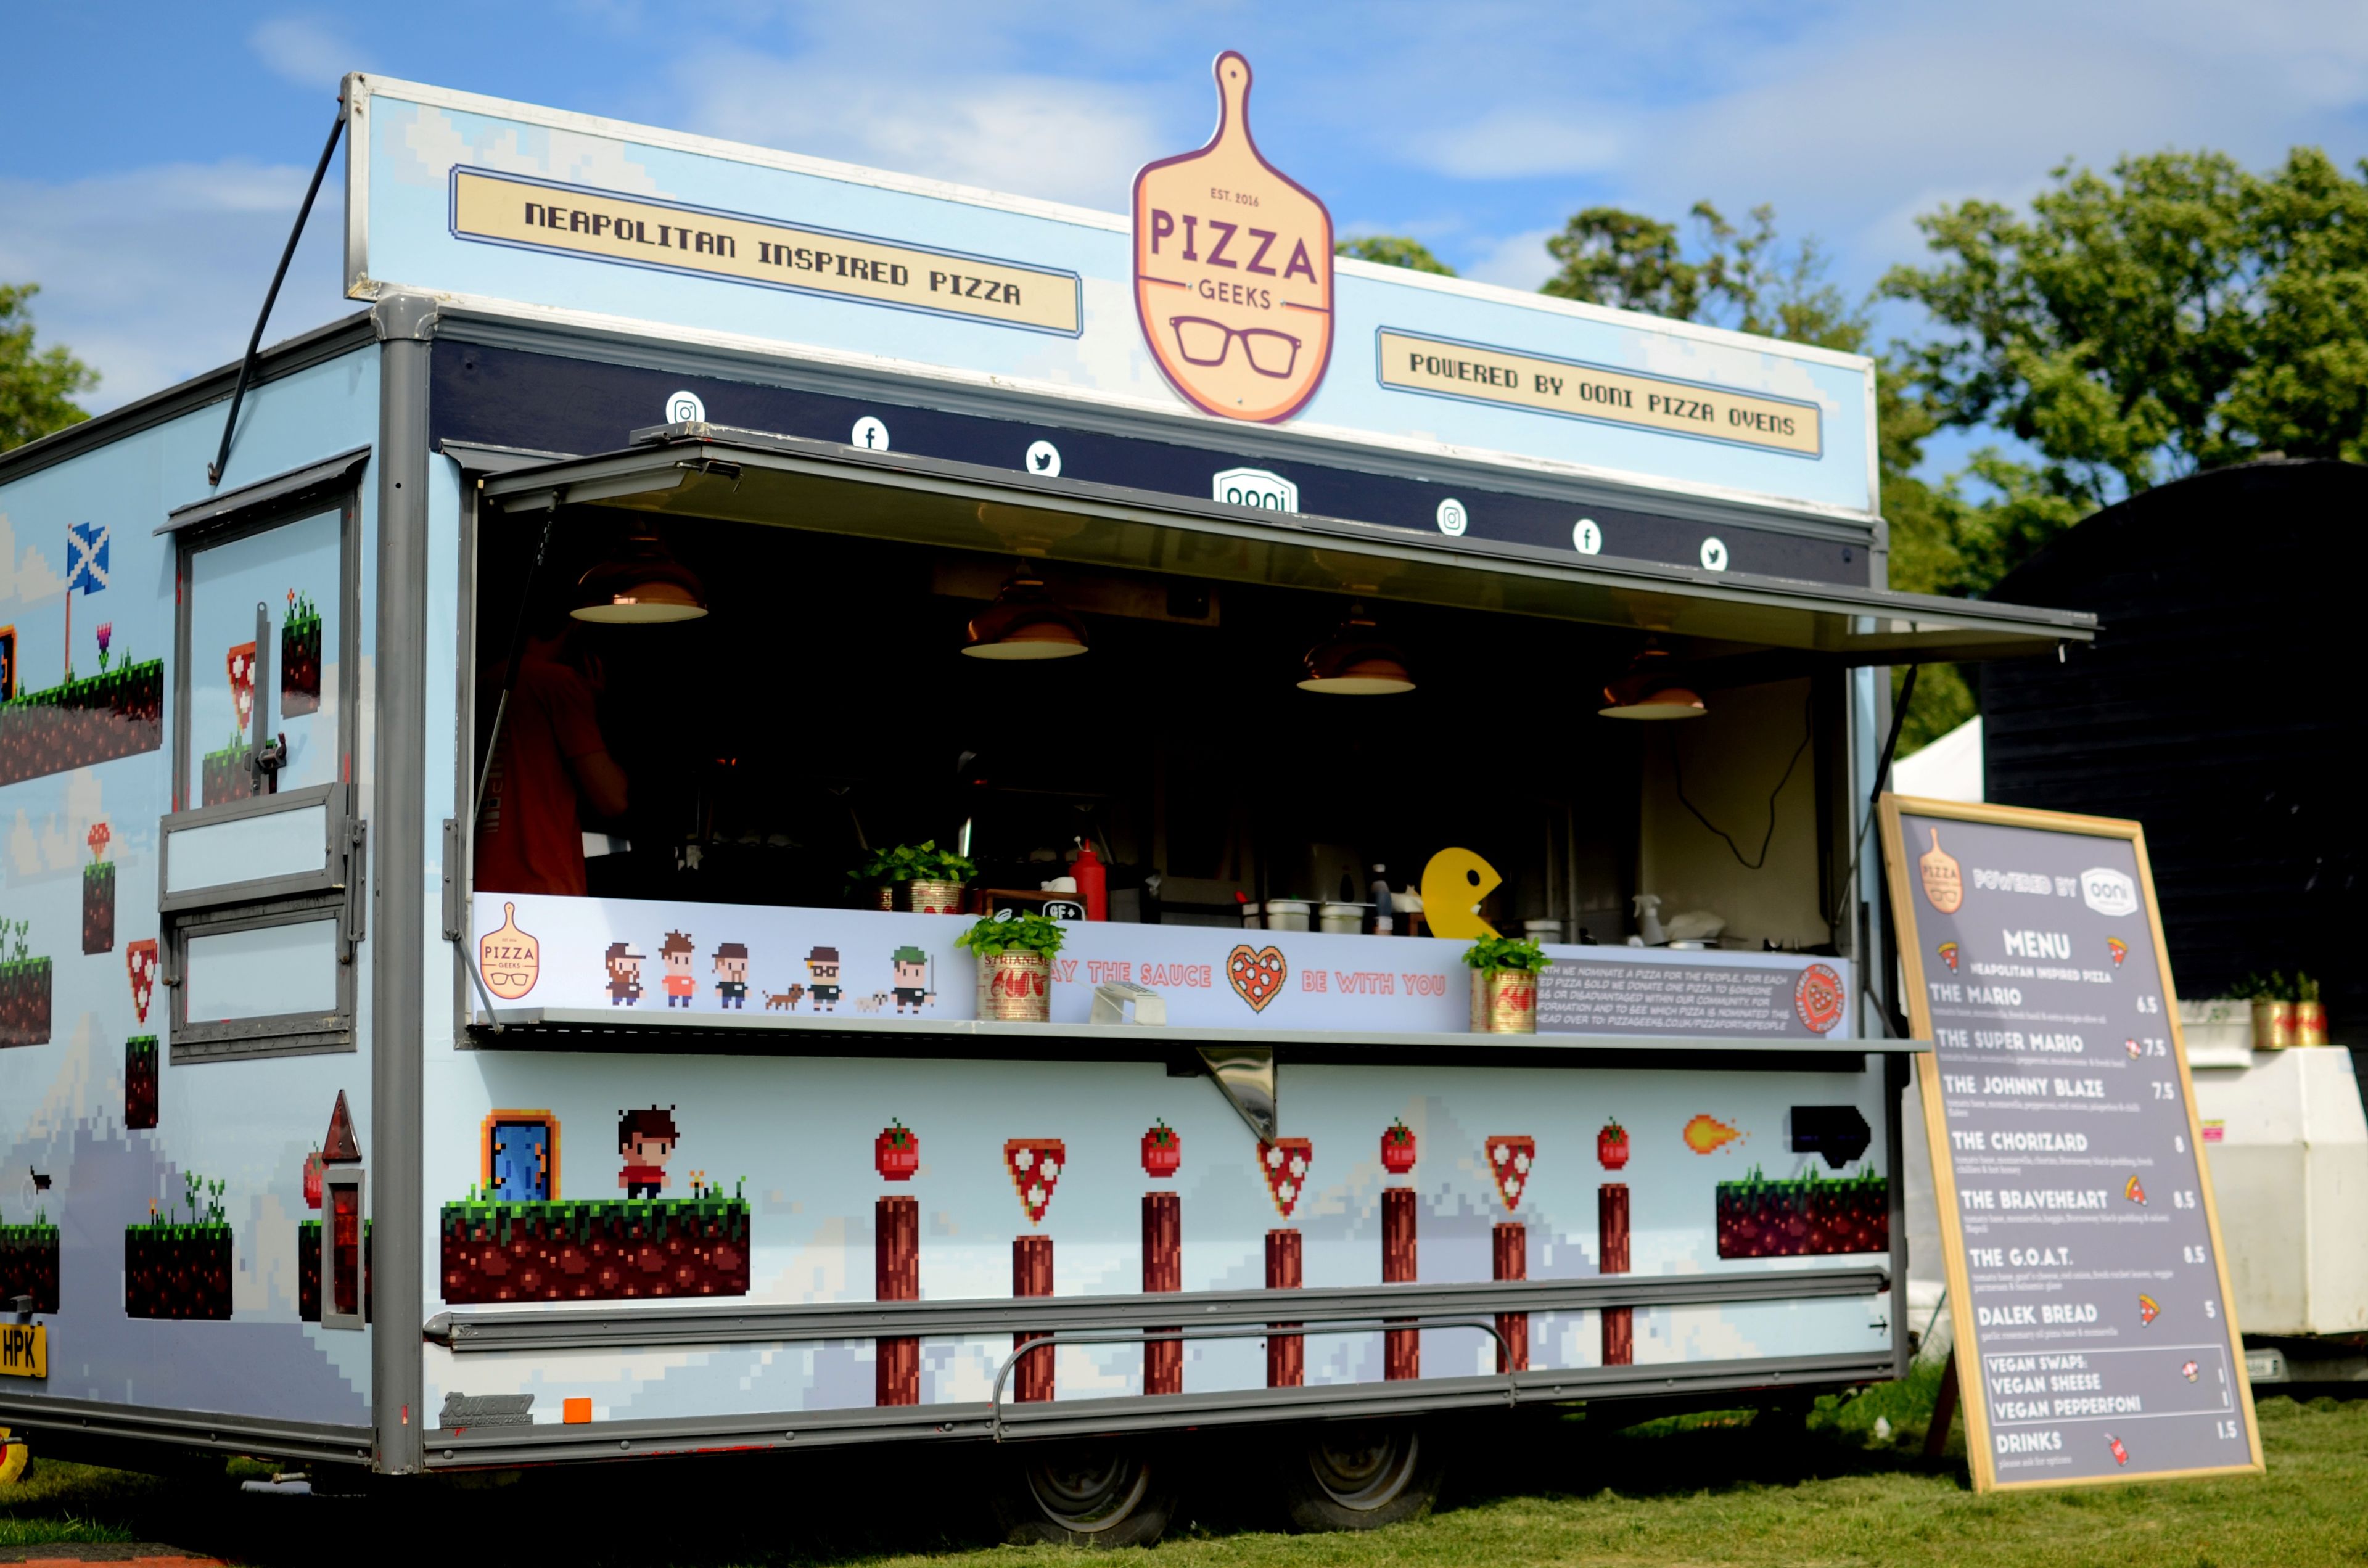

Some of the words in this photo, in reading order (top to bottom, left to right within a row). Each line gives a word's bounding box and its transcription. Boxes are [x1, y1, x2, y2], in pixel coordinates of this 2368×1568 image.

[1211, 188, 1232, 202] EST.
[1235, 193, 1259, 207] 2016
[525, 202, 736, 258] NEAPOLITAN
[758, 242, 908, 287] INSPIRED
[930, 270, 1021, 306] PIZZA
[1151, 208, 1318, 285] PIZZA
[1199, 279, 1271, 310] GEEKS
[1410, 352, 1518, 388] POWERED
[1535, 374, 1563, 396] BY
[1581, 383, 1634, 408] OONI
[1648, 395, 1714, 422] PIZZA
[1729, 409, 1796, 436] OVENS
[1227, 488, 1285, 511] ooni
[1923, 865, 1957, 879] PIZZA
[1972, 868, 2052, 895] POWERED
[2055, 877, 2077, 898] BY
[2091, 882, 2128, 900] ooni
[485, 946, 534, 960] PIZZA
[2003, 929, 2071, 960] MENU
[1051, 959, 1078, 982] AY
[1087, 960, 1131, 984] THE
[1140, 963, 1212, 988] SAUCE
[1302, 970, 1328, 993] BE
[1336, 971, 1395, 995] WITH
[1402, 974, 1446, 997] YOU
[1635, 969, 1661, 980] PIZZA
[1663, 971, 1682, 980] FOR
[1685, 972, 1702, 982] THE
[1743, 974, 1762, 983] FOR
[1970, 963, 2034, 980] NEAPOLITAN
[2037, 968, 2081, 982] INSPIRED
[2082, 971, 2113, 984] PIZZA
[1555, 978, 1581, 988] PIZZA
[1665, 983, 1685, 993] ONE
[1687, 983, 1712, 994] PIZZA
[1716, 985, 1727, 994] TO
[1929, 983, 1962, 1003] THE
[1967, 985, 2023, 1006] MARIO
[1616, 1005, 1627, 1014] TO
[1679, 1007, 1704, 1017] PIZZA
[1753, 998, 1770, 1008] FOR
[2136, 995, 2158, 1014] 6.5
[1563, 1015, 1589, 1024] OVER
[1936, 1029, 1970, 1048] THE
[1975, 1030, 2026, 1051] SUPER
[2029, 1033, 2084, 1053] MARIO
[2143, 1038, 2166, 1057] 7.5
[1943, 1075, 1977, 1094] THE
[1983, 1075, 2049, 1096] JOHNNY
[2054, 1078, 2105, 1099] BLAZE
[2152, 1081, 2175, 1101] 7.5
[1952, 1131, 1986, 1151] THE
[1991, 1131, 2088, 1152] CHORIZARD
[2174, 1135, 2185, 1154] 8
[1960, 1190, 1996, 1209] THE
[1999, 1189, 2108, 1209] BRAVEHEART
[2173, 1191, 2195, 1209] 8.5
[1969, 1248, 2004, 1268] THE
[2009, 1247, 2074, 1267] G.O.A.T.
[2183, 1246, 2206, 1264] 8.5
[1978, 1305, 2038, 1326] DALEK
[2042, 1303, 2098, 1324] BREAD
[2204, 1300, 2216, 1319] 5
[3, 1329, 35, 1369] HPK
[1988, 1357, 2036, 1373] VEGAN
[1991, 1376, 2047, 1395] VEGAN
[2050, 1373, 2102, 1392] SHEESE
[1996, 1400, 2050, 1419] VEGAN
[2054, 1395, 2142, 1416] PEPPERFONI
[1996, 1432, 2062, 1454] DRINKS
